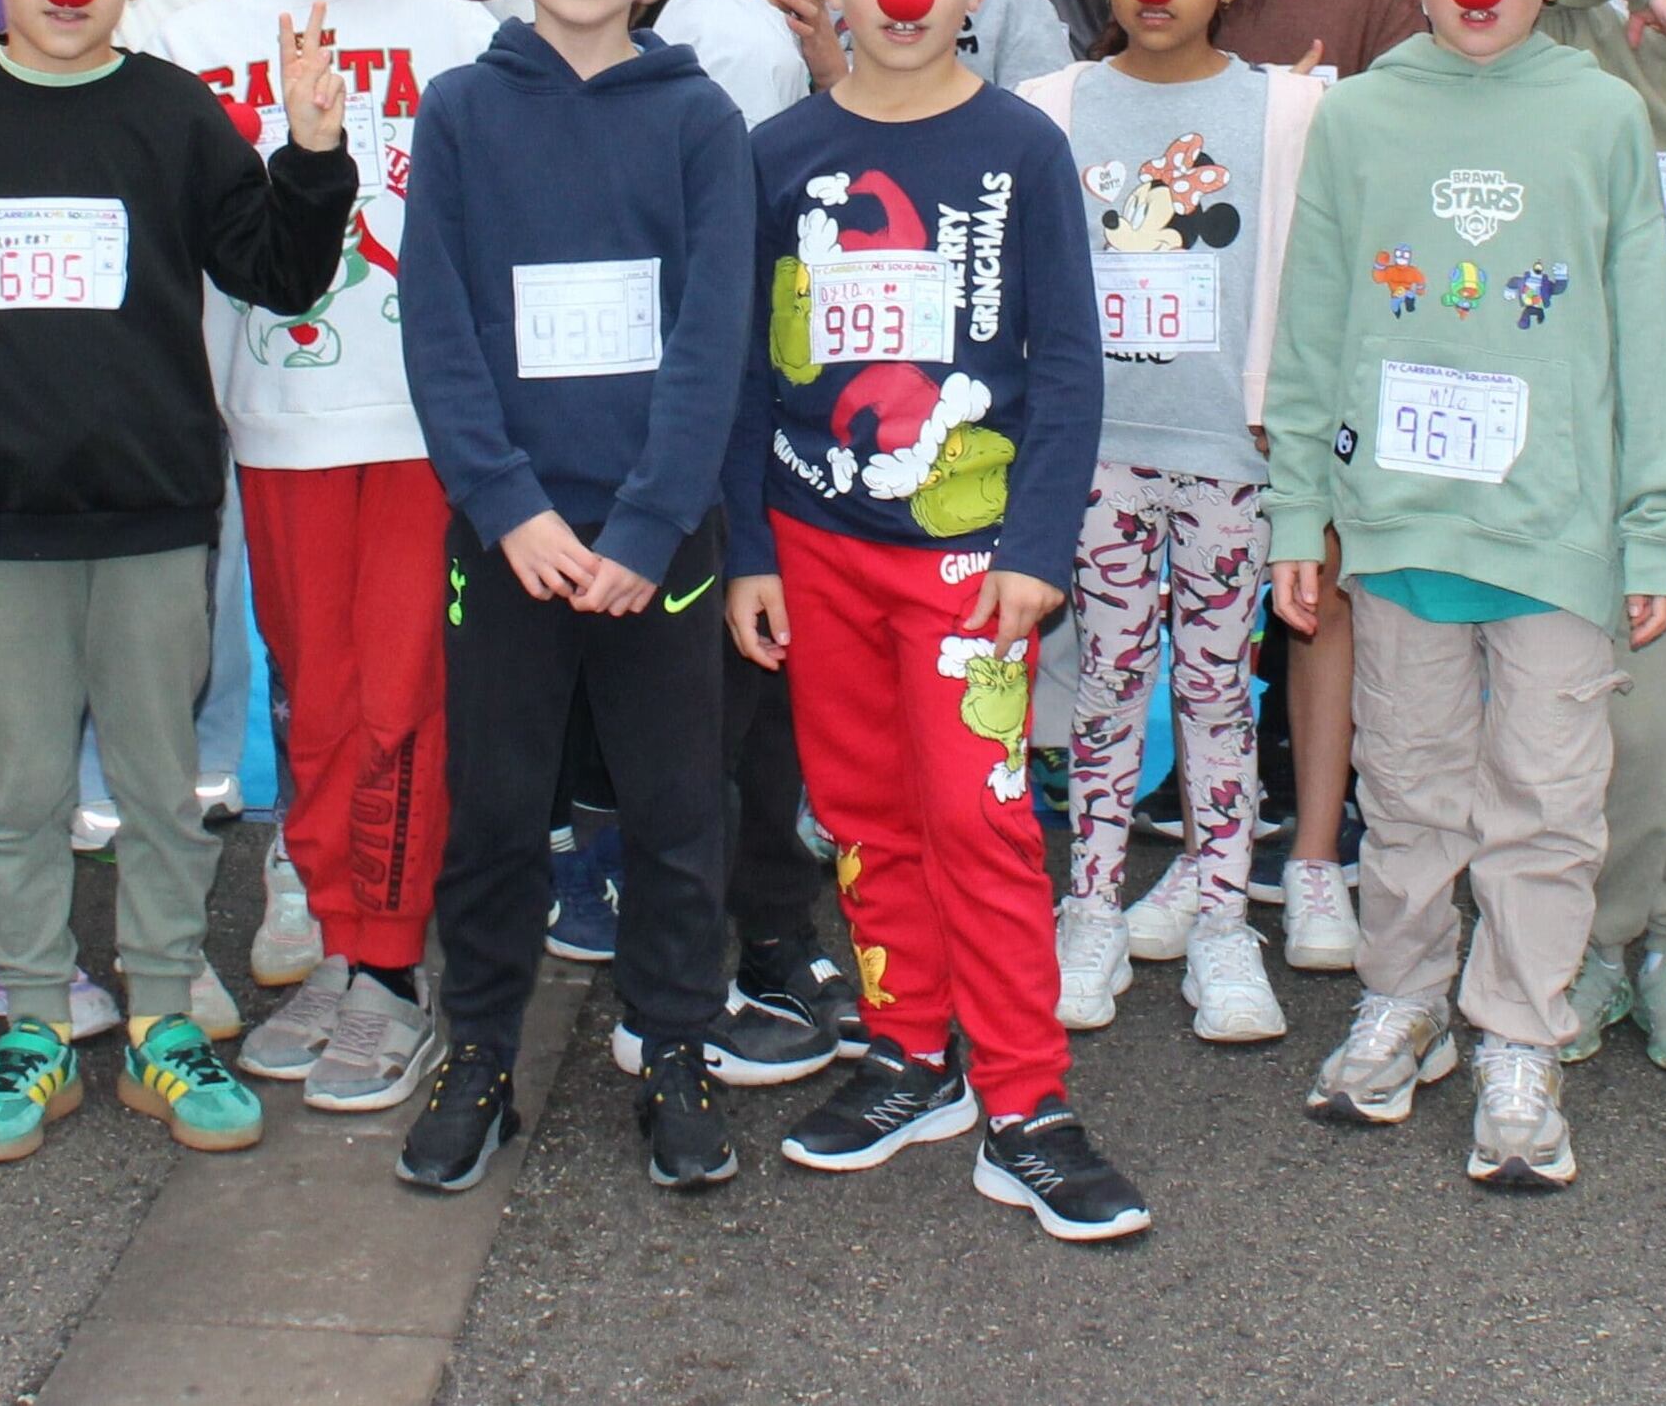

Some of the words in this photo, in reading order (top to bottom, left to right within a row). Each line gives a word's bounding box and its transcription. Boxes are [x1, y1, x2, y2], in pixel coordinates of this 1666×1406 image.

[198, 48, 422, 118] SATA
[1434, 181, 1521, 214] STARS
[1451, 171, 1503, 185] BRAWL
[0, 251, 85, 302] 685
[968, 172, 1013, 342] GRINCHMAS
[825, 303, 904, 355] 993
[1399, 364, 1443, 376] CARRERA
[1397, 406, 1477, 461] 967
[939, 551, 992, 585] GRIN
